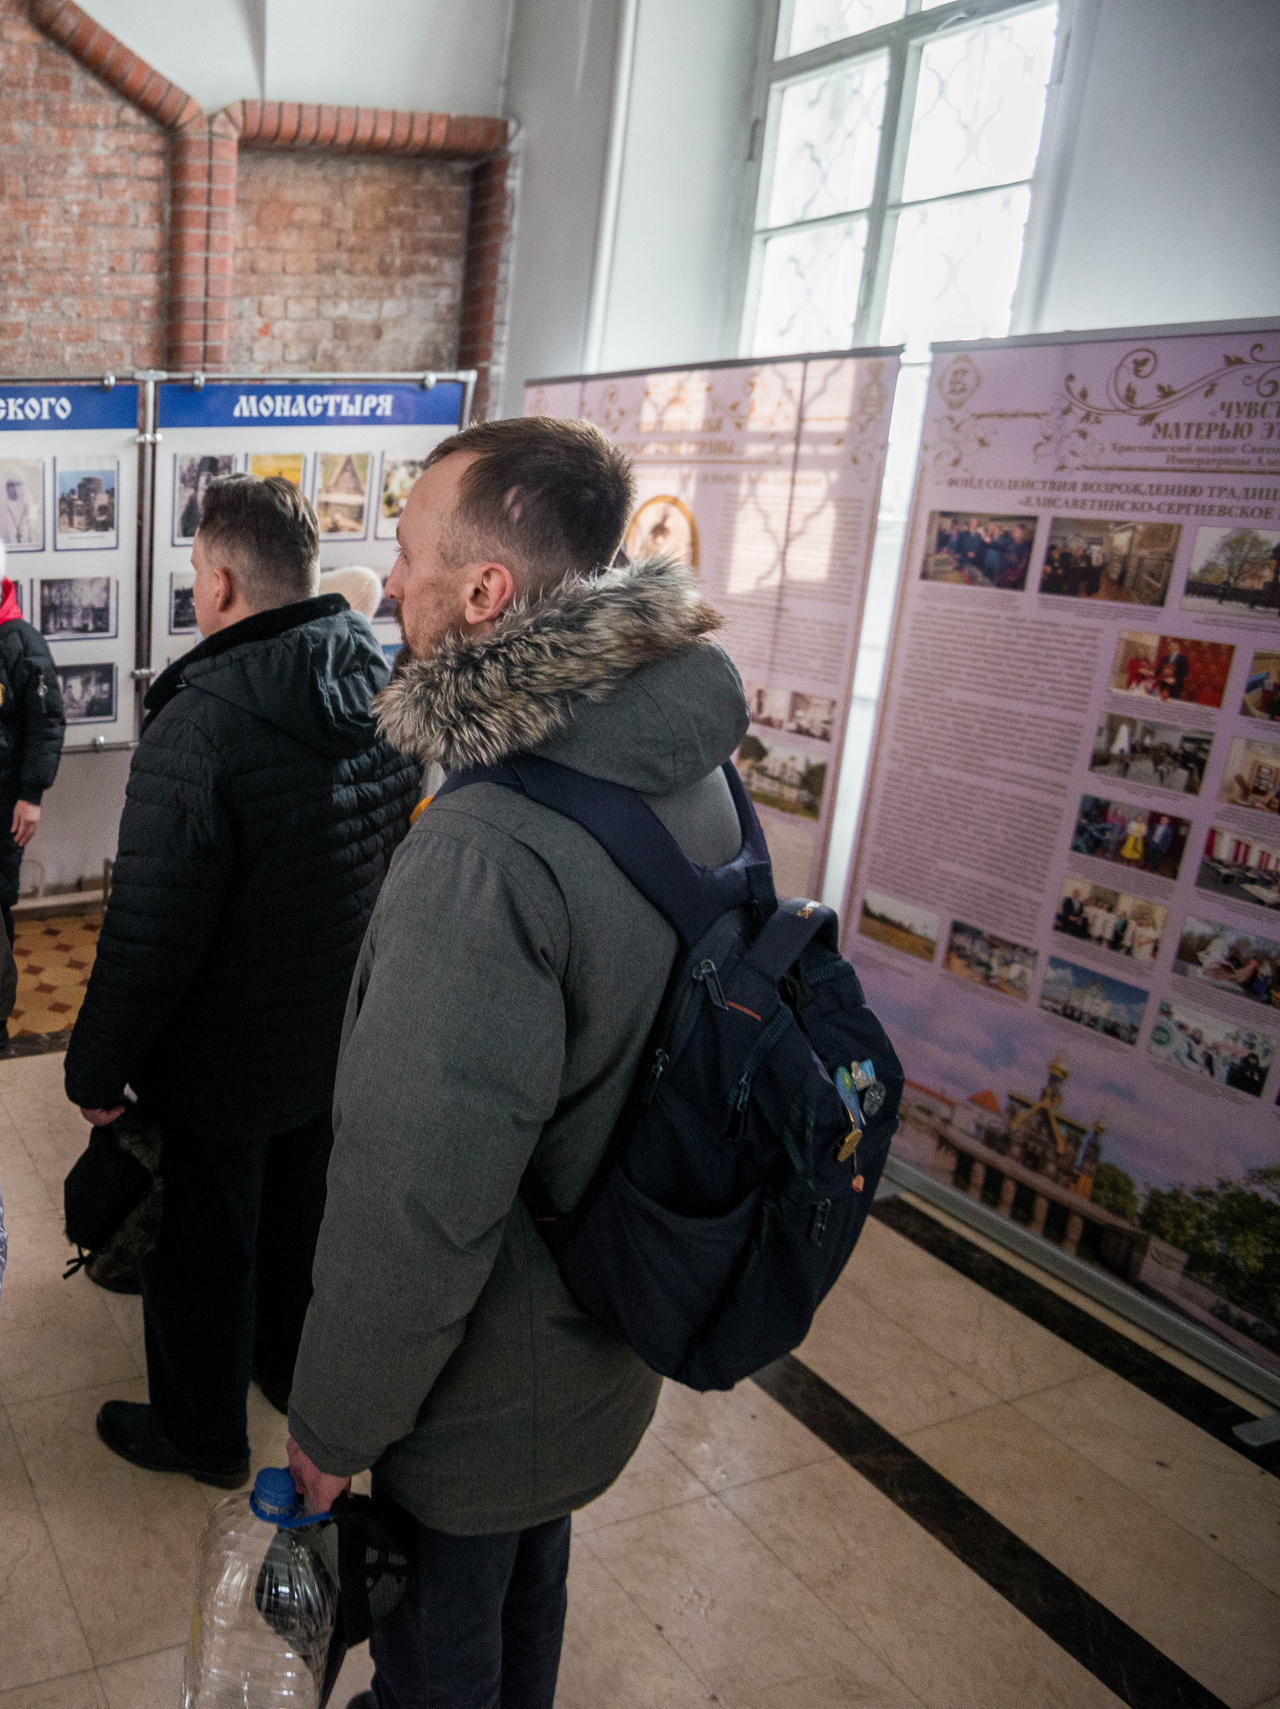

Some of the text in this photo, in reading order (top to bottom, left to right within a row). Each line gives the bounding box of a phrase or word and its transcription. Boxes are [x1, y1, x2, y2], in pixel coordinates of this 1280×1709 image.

[232, 394, 393, 418] МОНАСТЫРЯ
[1151, 421, 1254, 440] МАТЕРЬЮ
[1080, 481, 1204, 498] ВОЗРОЖДЕНИЮ
